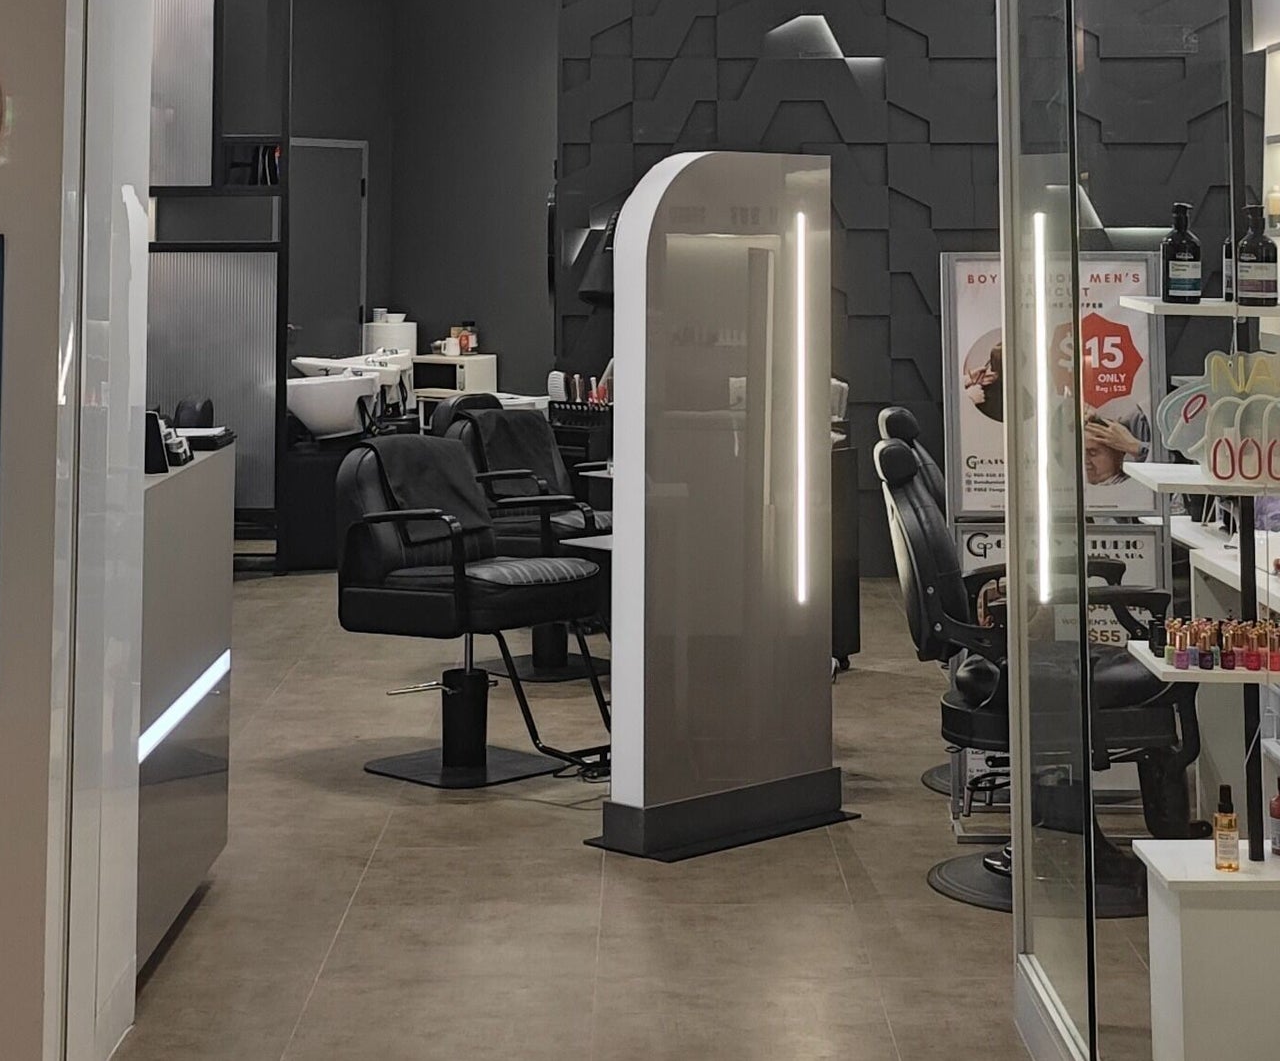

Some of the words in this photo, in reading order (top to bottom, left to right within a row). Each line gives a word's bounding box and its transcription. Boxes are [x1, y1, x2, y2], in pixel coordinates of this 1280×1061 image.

[1090, 273, 1140, 284] MEN'S
[1098, 374, 1126, 383] ONLY
[1088, 628, 1120, 642] $55
